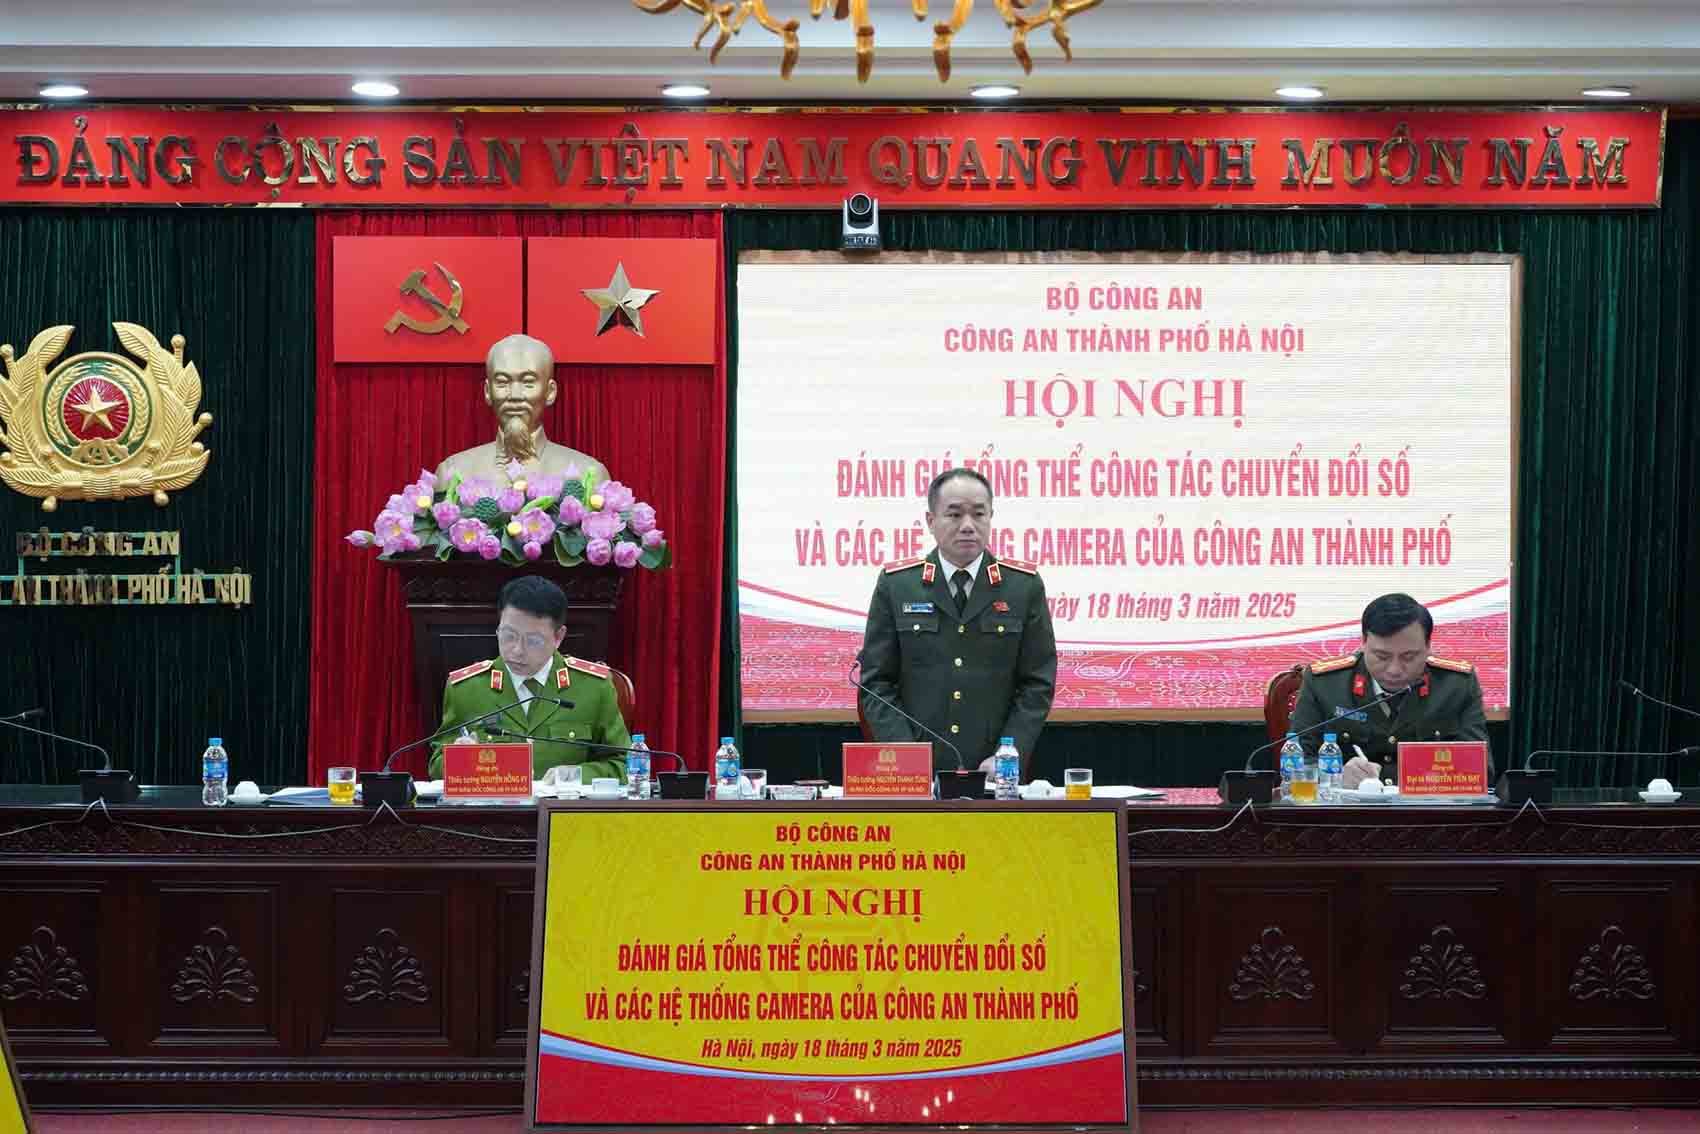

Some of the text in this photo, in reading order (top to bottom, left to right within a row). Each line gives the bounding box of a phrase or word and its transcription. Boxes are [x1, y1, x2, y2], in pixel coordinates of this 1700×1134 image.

[15, 115, 1631, 201] ĐẢNG CỘNG SẢN VIỆT NAM QUANG VINH MUÔN NĂM
[1046, 283, 1203, 317] BỘ CÔNG AN
[944, 319, 1304, 357] CÔNG AN THÀNH PHỐ HÀ NỘI
[1004, 374, 1245, 429] HỘI NGHỊ
[836, 450, 906, 497] ĐÁNH
[1037, 443, 1084, 497] THỂ
[1089, 450, 1159, 497] CÔNG
[1165, 450, 1213, 497] TÁC
[1221, 443, 1320, 497] CHUYỂN
[1328, 443, 1369, 497] ĐỔI
[1377, 445, 1411, 497] SỐ
[61, 526, 134, 556] CÔNG
[143, 531, 180, 556] AN
[795, 519, 827, 567] VÀ
[835, 520, 885, 567] CÁC
[1023, 527, 1127, 567] CAMERA
[1135, 513, 1185, 567] CỦA
[1193, 519, 1262, 567] CÔNG
[1269, 527, 1305, 567] AN
[1313, 519, 1395, 567] THÀNH
[1402, 513, 1453, 567] PHỐ
[127, 563, 171, 605] PHỐ
[176, 568, 206, 605] HÀ
[213, 566, 253, 609] NỘI
[1046, 591, 1297, 624] gày 18 tháng 3 năm 2025
[775, 823, 891, 846] BỘ CÔNG AN
[700, 847, 966, 875] CÔNG AN THÀNH PHỐ HÀ NỘI
[743, 884, 923, 923] HỘI NGHỊ
[618, 931, 1047, 972] ĐÁNH GIÁ TỔNG THỂ CÔNG TÁC CHUYỂN ĐỔI SỐ
[585, 981, 1080, 1027] VÀ CÁC HỆ THỐNG CAMERA CỦA CÔNG AN THÀNH PHỐ
[701, 1037, 963, 1061] Hà Nội, ngày 18 tháng 3 năm 2025
